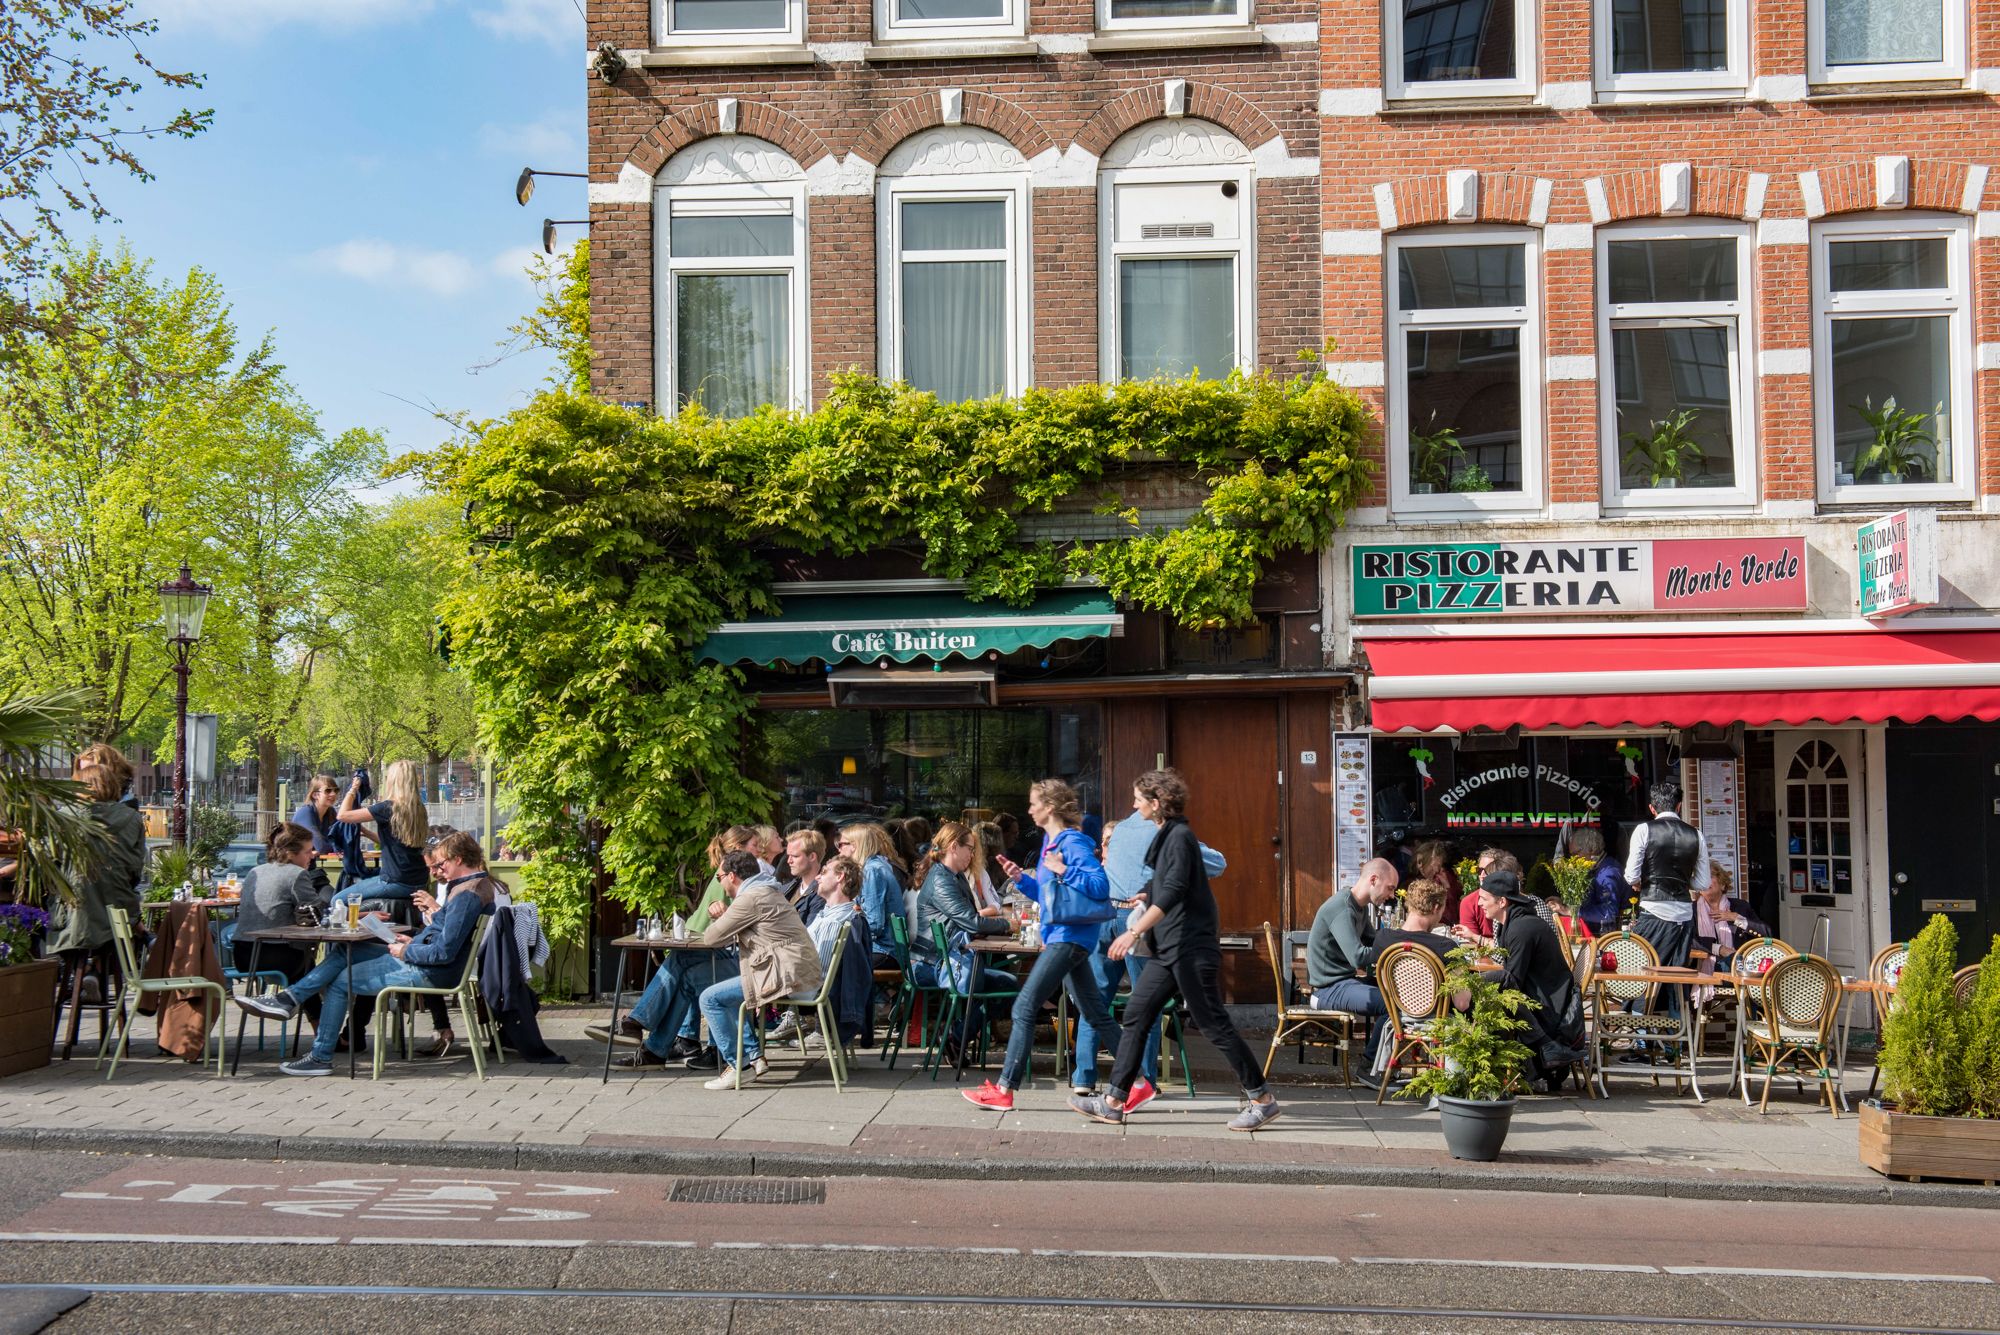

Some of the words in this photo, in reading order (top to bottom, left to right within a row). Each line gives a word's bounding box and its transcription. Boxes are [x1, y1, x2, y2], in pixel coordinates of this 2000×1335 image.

[1861, 521, 1906, 555] RISTORANTE
[1362, 547, 1639, 578] RISTORANTE
[1664, 560, 1732, 600] Monte
[1740, 547, 1799, 586] Verde
[1865, 551, 1904, 582] PIZZERIA
[1383, 580, 1621, 610] PIZZERIA
[1864, 585, 1886, 608] Monte
[1888, 579, 1907, 601] Verde
[831, 632, 886, 653] Café
[893, 631, 976, 651] Buiten
[1304, 753, 1314, 761] 13
[1439, 763, 1530, 810] Ristorante
[1535, 764, 1602, 809] Pizzeria
[1447, 812, 1525, 828] MONTE
[1527, 812, 1601, 828] VERDE
